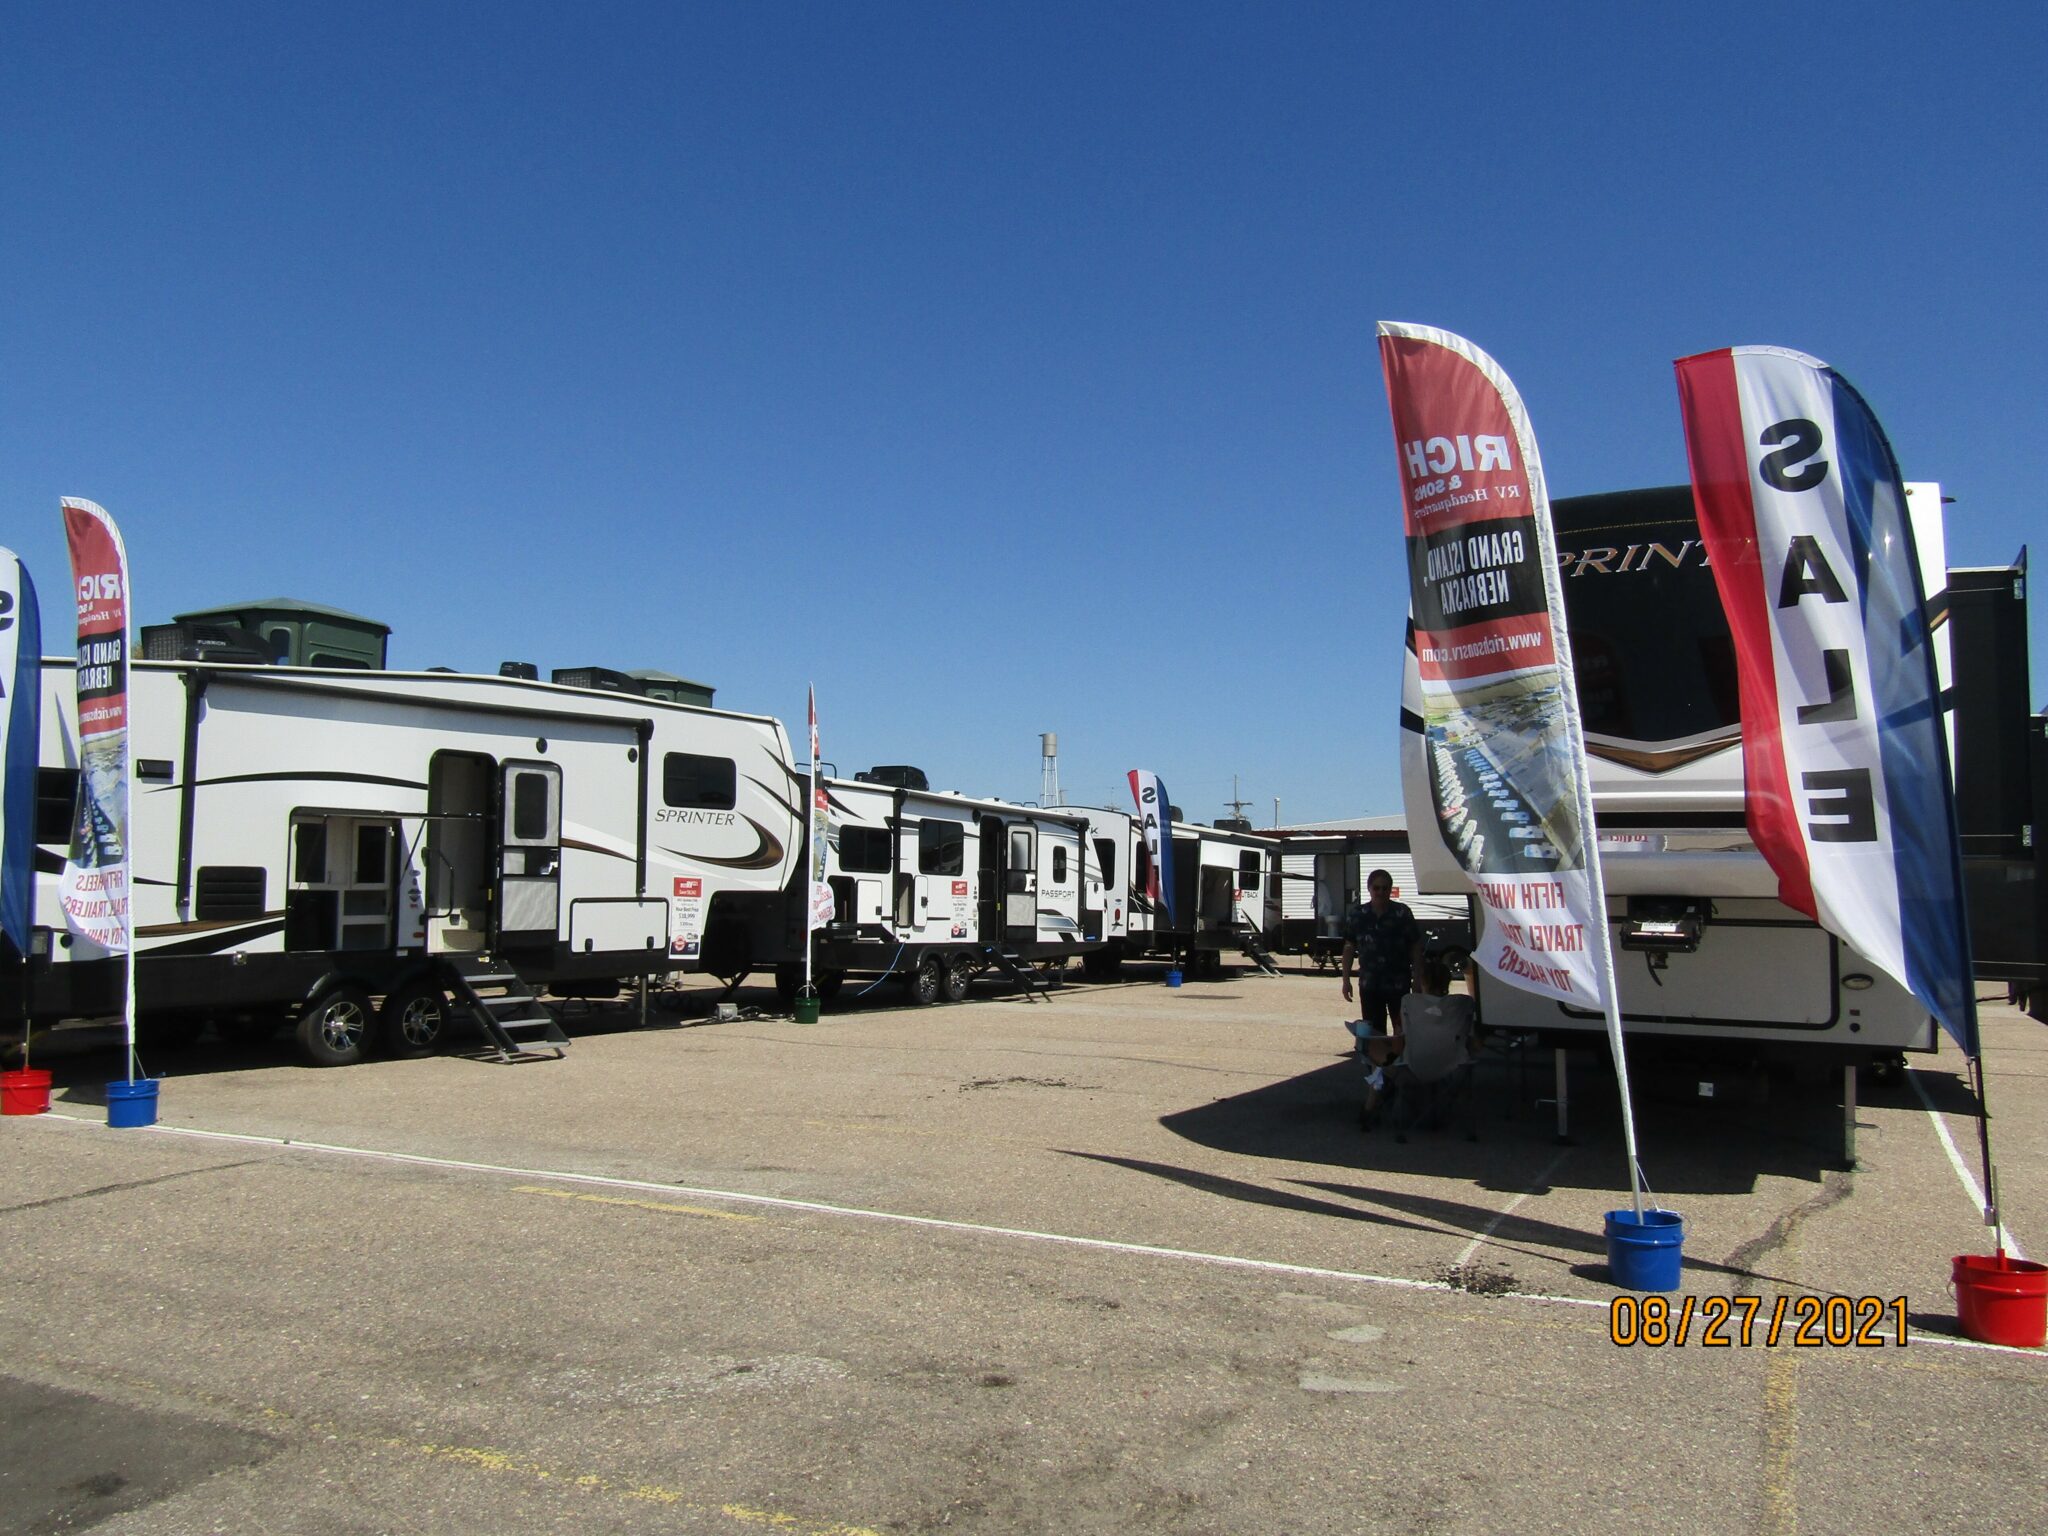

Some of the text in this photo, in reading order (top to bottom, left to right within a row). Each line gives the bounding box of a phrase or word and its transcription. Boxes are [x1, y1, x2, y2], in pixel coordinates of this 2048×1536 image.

[1556, 540, 1712, 578] PRIN
[655, 808, 736, 826] SPRINTER
[1041, 889, 1076, 898] PASSPORT
